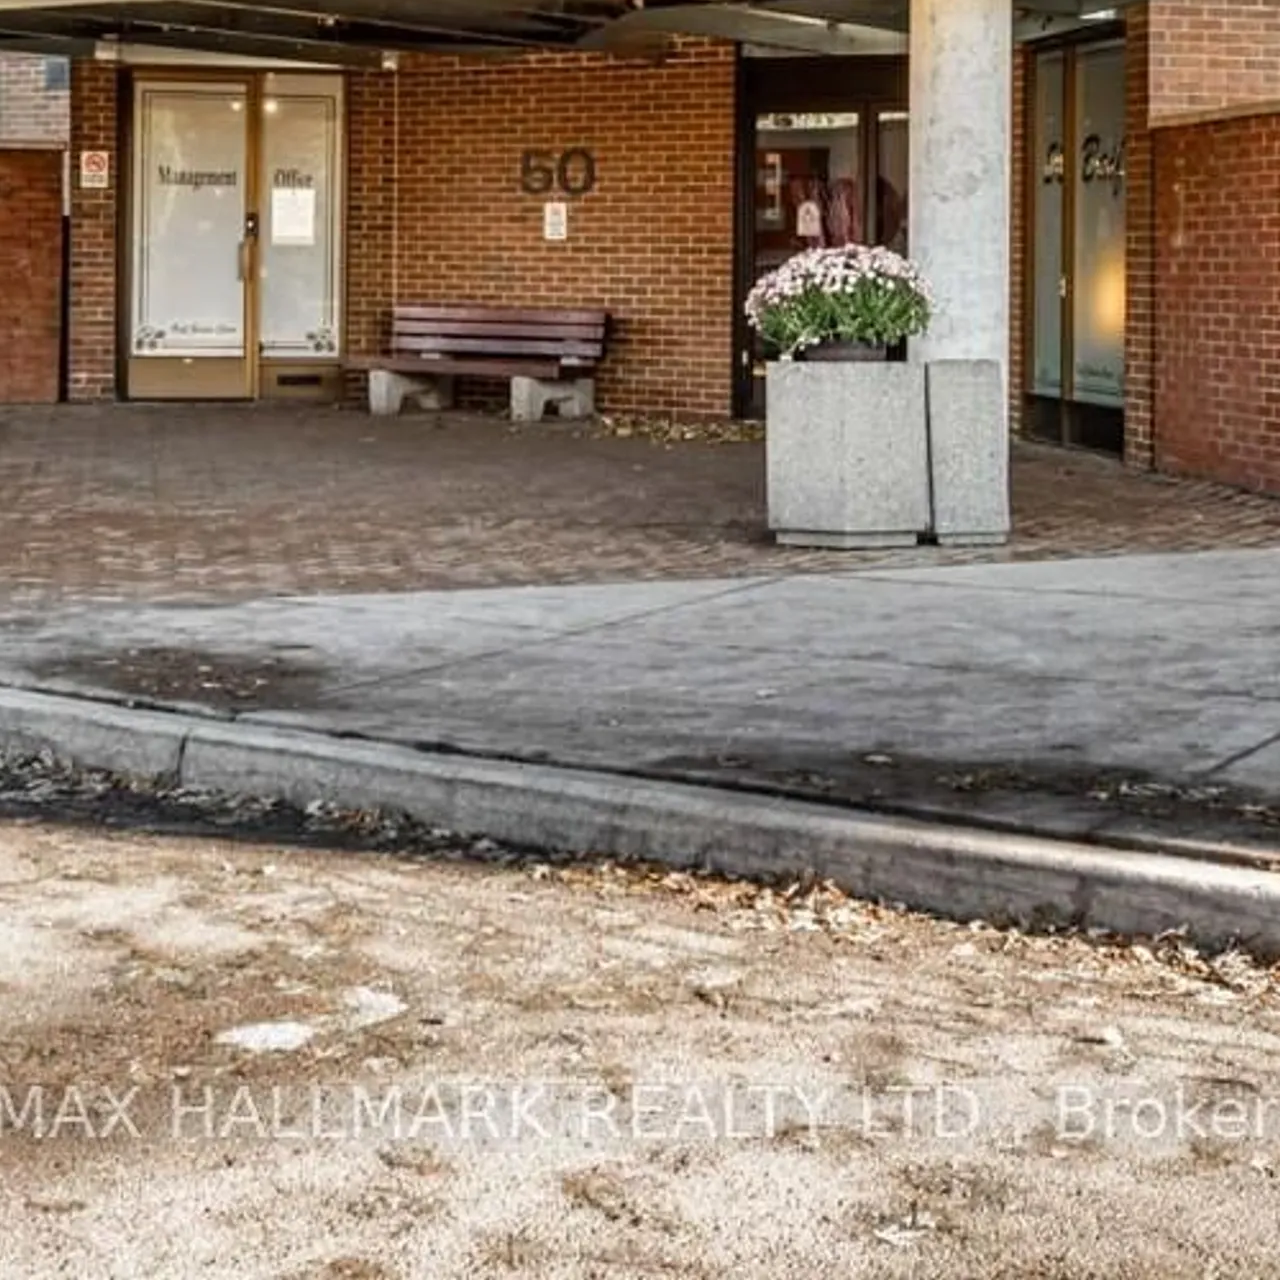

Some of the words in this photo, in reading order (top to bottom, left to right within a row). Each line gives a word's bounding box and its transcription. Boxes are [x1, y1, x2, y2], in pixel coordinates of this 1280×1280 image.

[157, 164, 237, 191] Management
[273, 168, 314, 187] Office
[522, 146, 595, 194] 50
